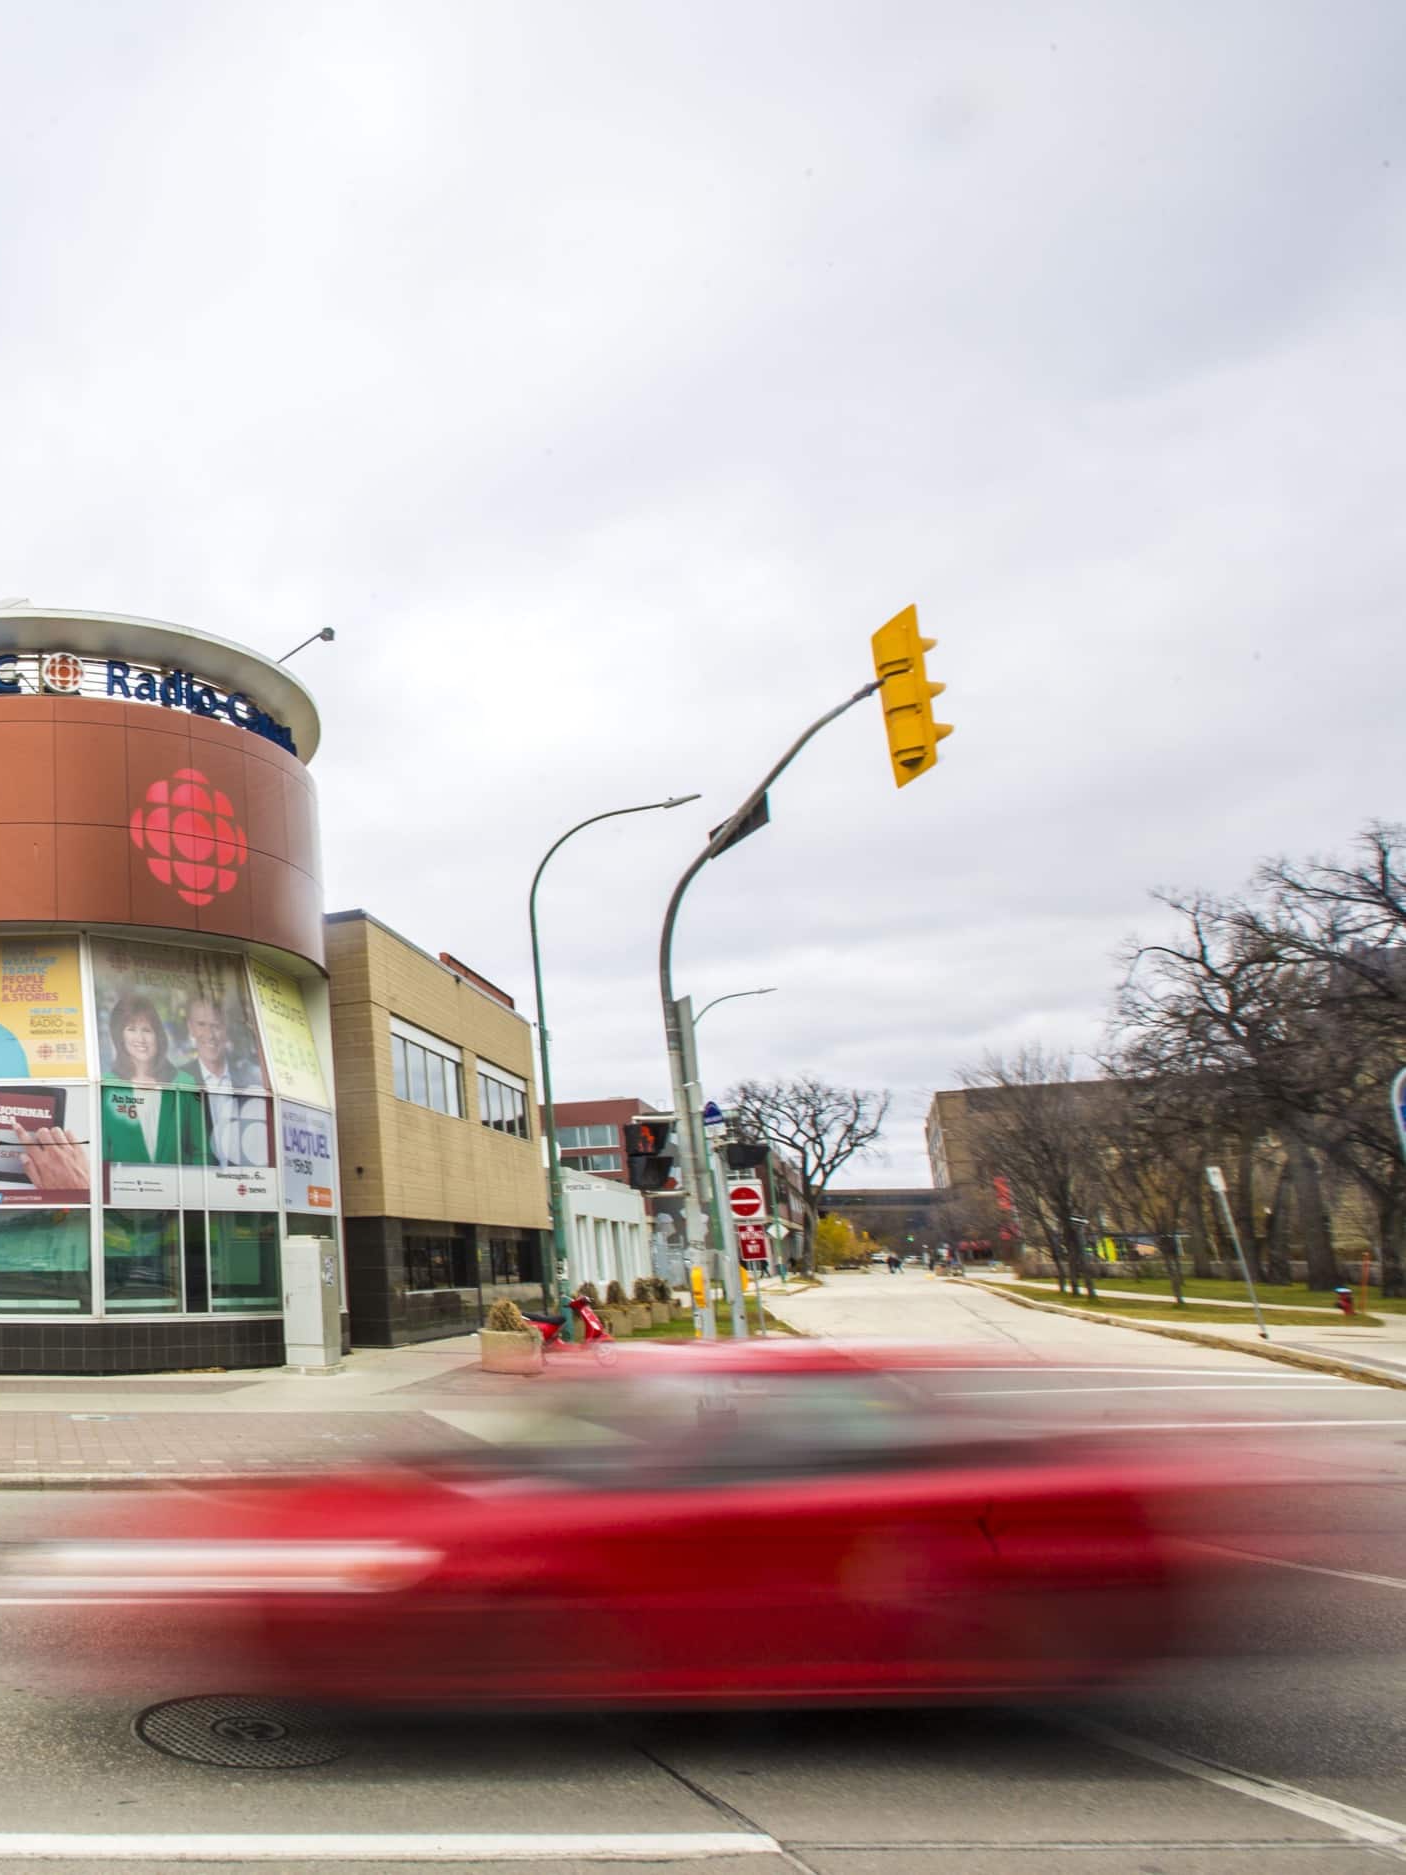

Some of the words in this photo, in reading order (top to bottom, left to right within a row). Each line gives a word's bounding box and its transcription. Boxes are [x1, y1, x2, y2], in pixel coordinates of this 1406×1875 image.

[2, 975, 44, 984] PEOPLE
[2, 984, 43, 993] PLACES
[30, 1018, 64, 1028] RADIO
[128, 1105, 137, 1119] 6
